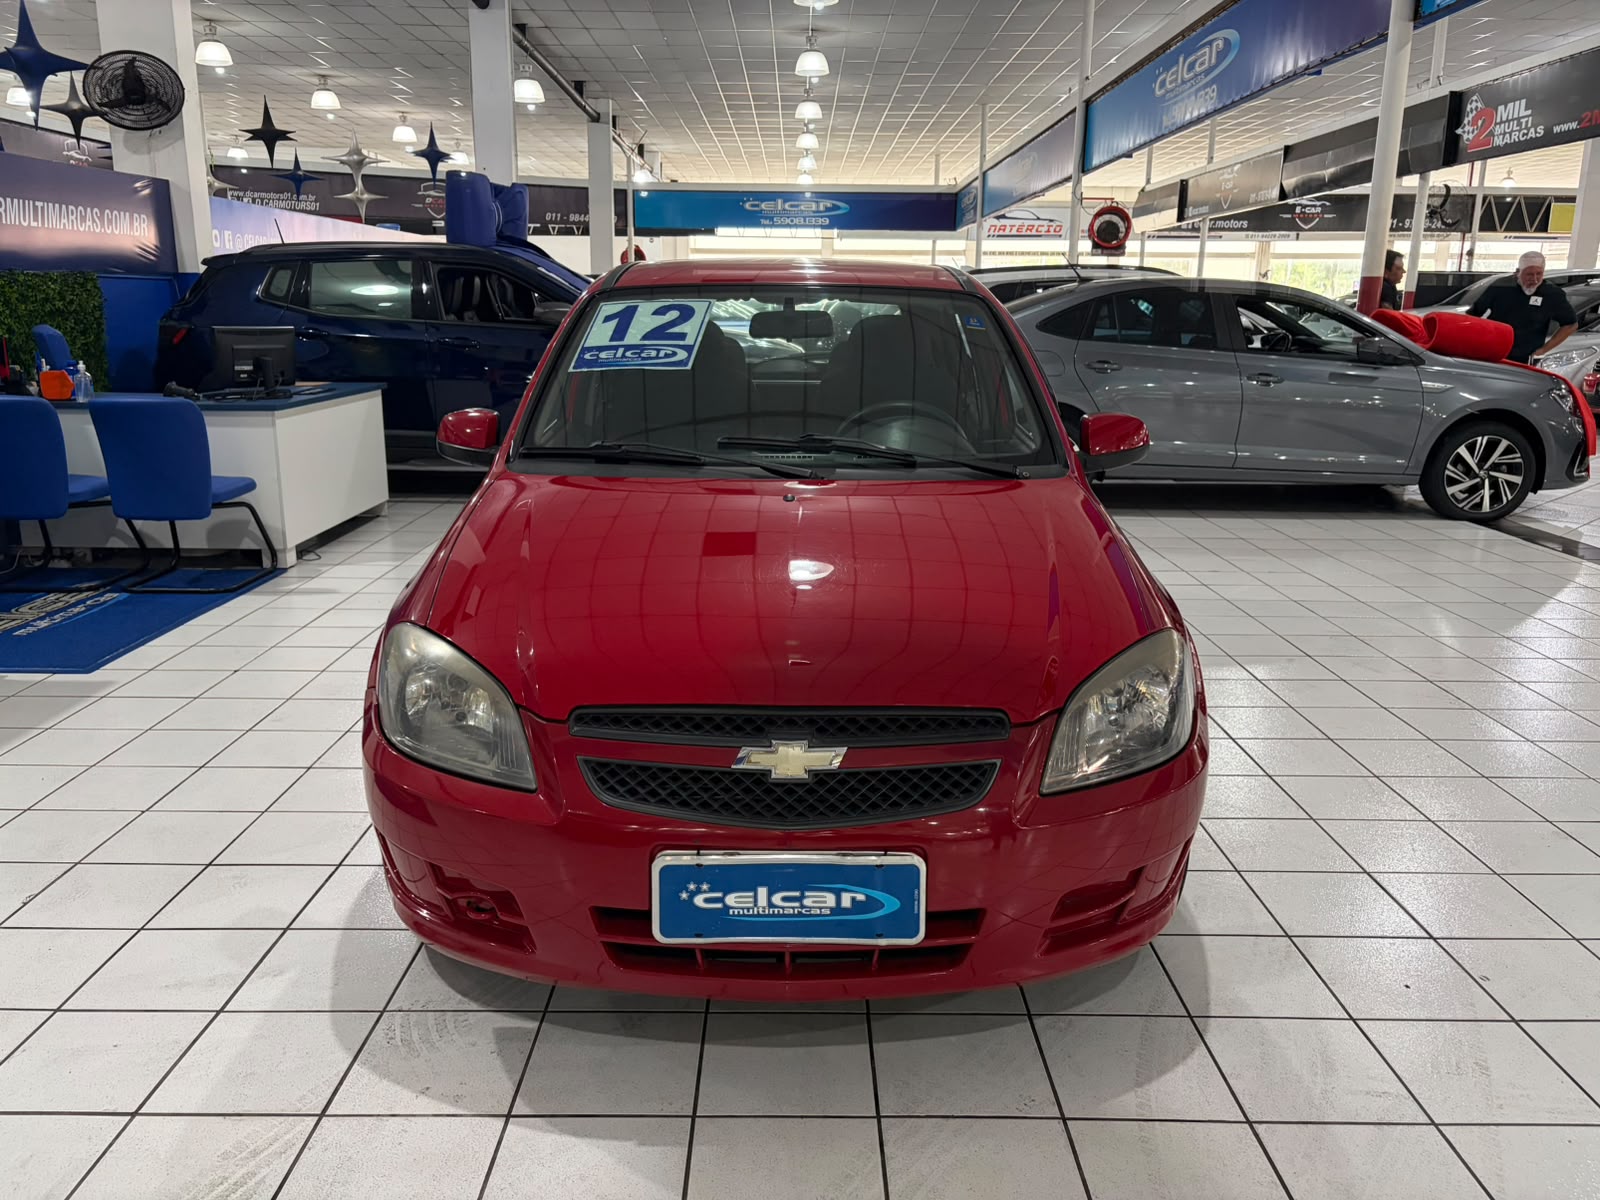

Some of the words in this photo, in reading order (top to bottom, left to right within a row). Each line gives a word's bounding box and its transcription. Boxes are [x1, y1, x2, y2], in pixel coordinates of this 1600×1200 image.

[1154, 37, 1225, 97] celcar
[1496, 98, 1532, 124] MIL
[1493, 125, 1544, 147] MARCAS
[1494, 117, 1532, 136] MULTI
[744, 199, 832, 211] celcar
[546, 212, 560, 221] 011
[602, 304, 696, 342] 12
[584, 348, 673, 360] celcar
[693, 886, 866, 909] celcar
[729, 907, 831, 916] multimarcas
